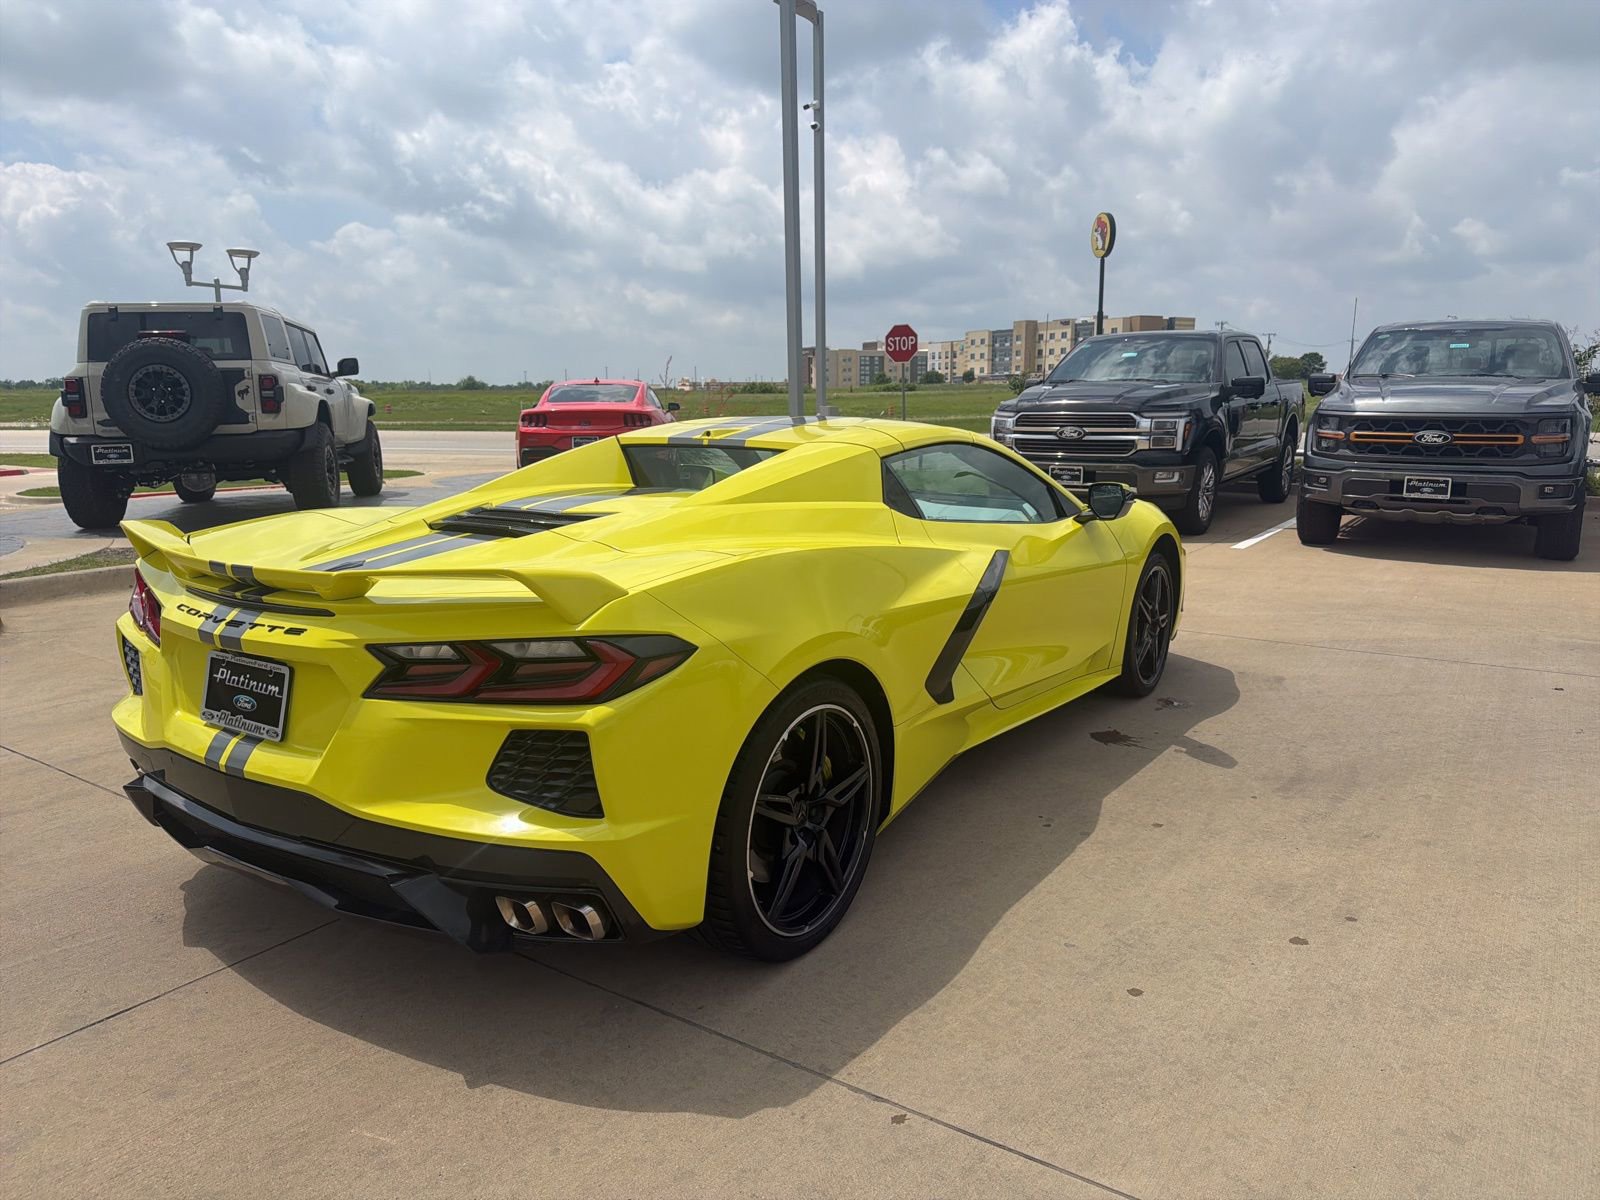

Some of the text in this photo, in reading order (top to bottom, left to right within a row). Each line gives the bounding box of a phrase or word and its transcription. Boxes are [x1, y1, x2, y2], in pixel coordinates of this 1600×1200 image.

[887, 336, 916, 352] STOP
[1061, 429, 1080, 438] Ford
[1421, 433, 1445, 442] Ford
[1408, 480, 1448, 488] Platinum
[176, 603, 308, 636] CORVETTE
[213, 667, 283, 698] Platinum
[236, 696, 253, 709] Ford
[218, 710, 264, 736] Platinum
